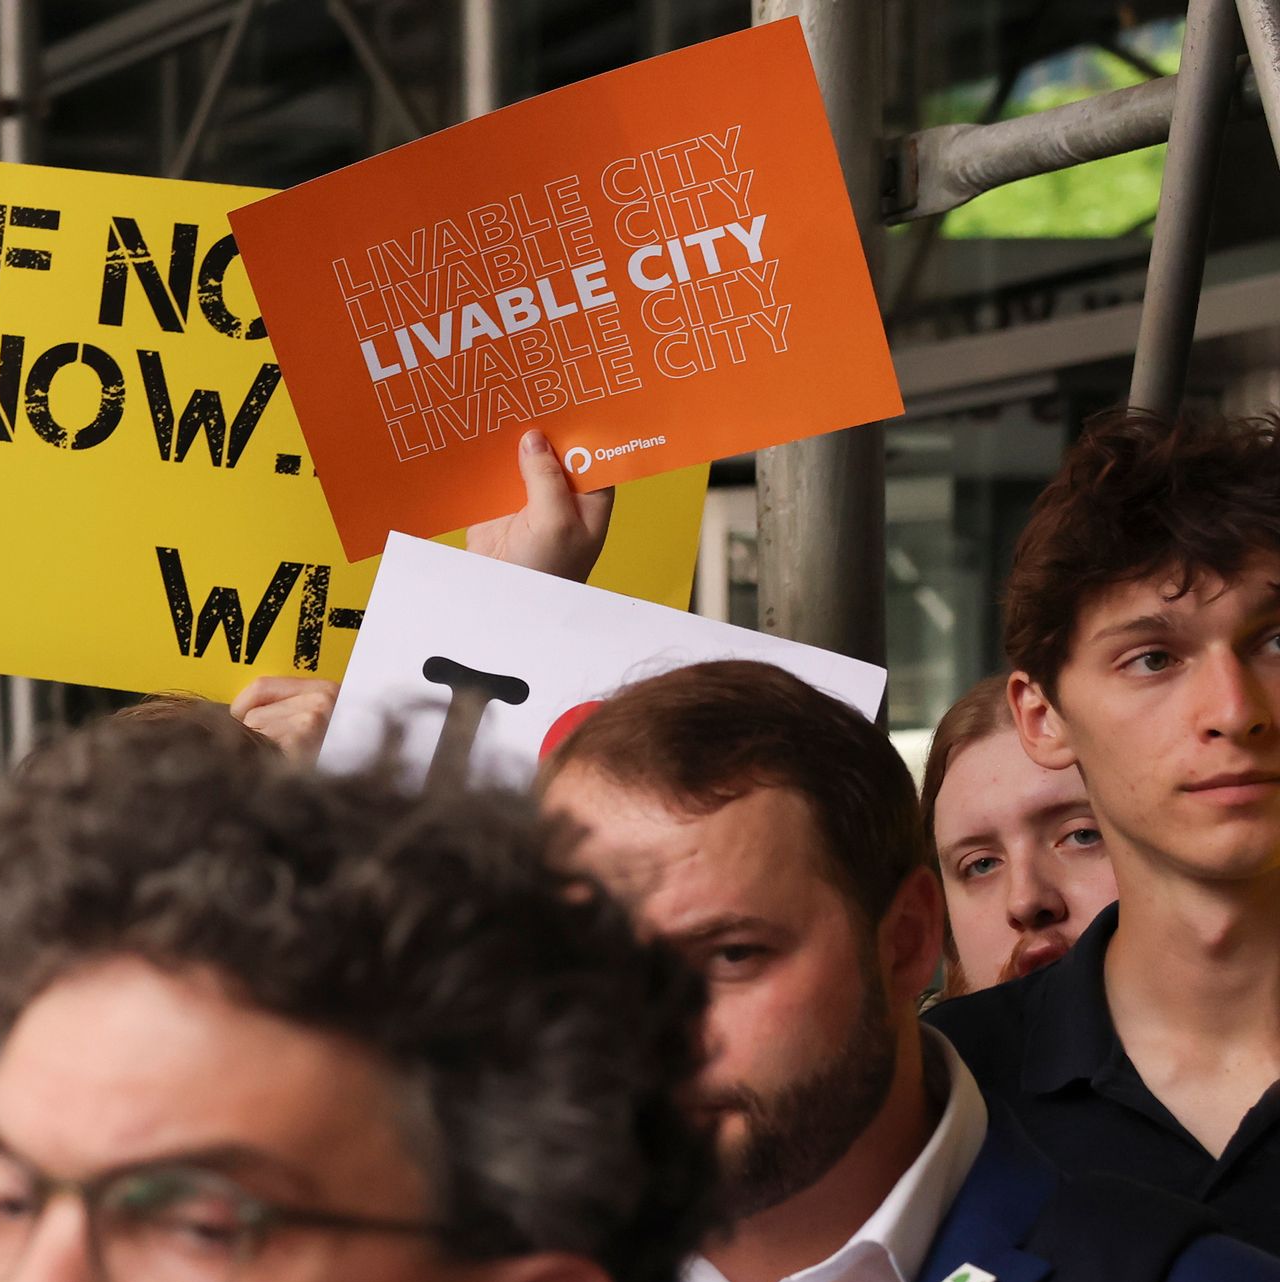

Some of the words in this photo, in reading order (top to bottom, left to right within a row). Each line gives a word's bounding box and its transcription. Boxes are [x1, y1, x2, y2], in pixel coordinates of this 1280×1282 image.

[98, 216, 266, 341] NO
[332, 175, 589, 301] LIVABLE
[602, 125, 741, 206] CITY
[346, 217, 603, 341] LIVABLE
[615, 169, 754, 249] CITY
[360, 261, 616, 383] LIVABLE
[629, 214, 767, 294] CITY
[373, 303, 629, 423] LIVABLE
[641, 259, 779, 336] CITY
[387, 346, 641, 464] LIVABLE
[654, 303, 792, 379] CITY
[594, 434, 667, 461] OpenPlans
